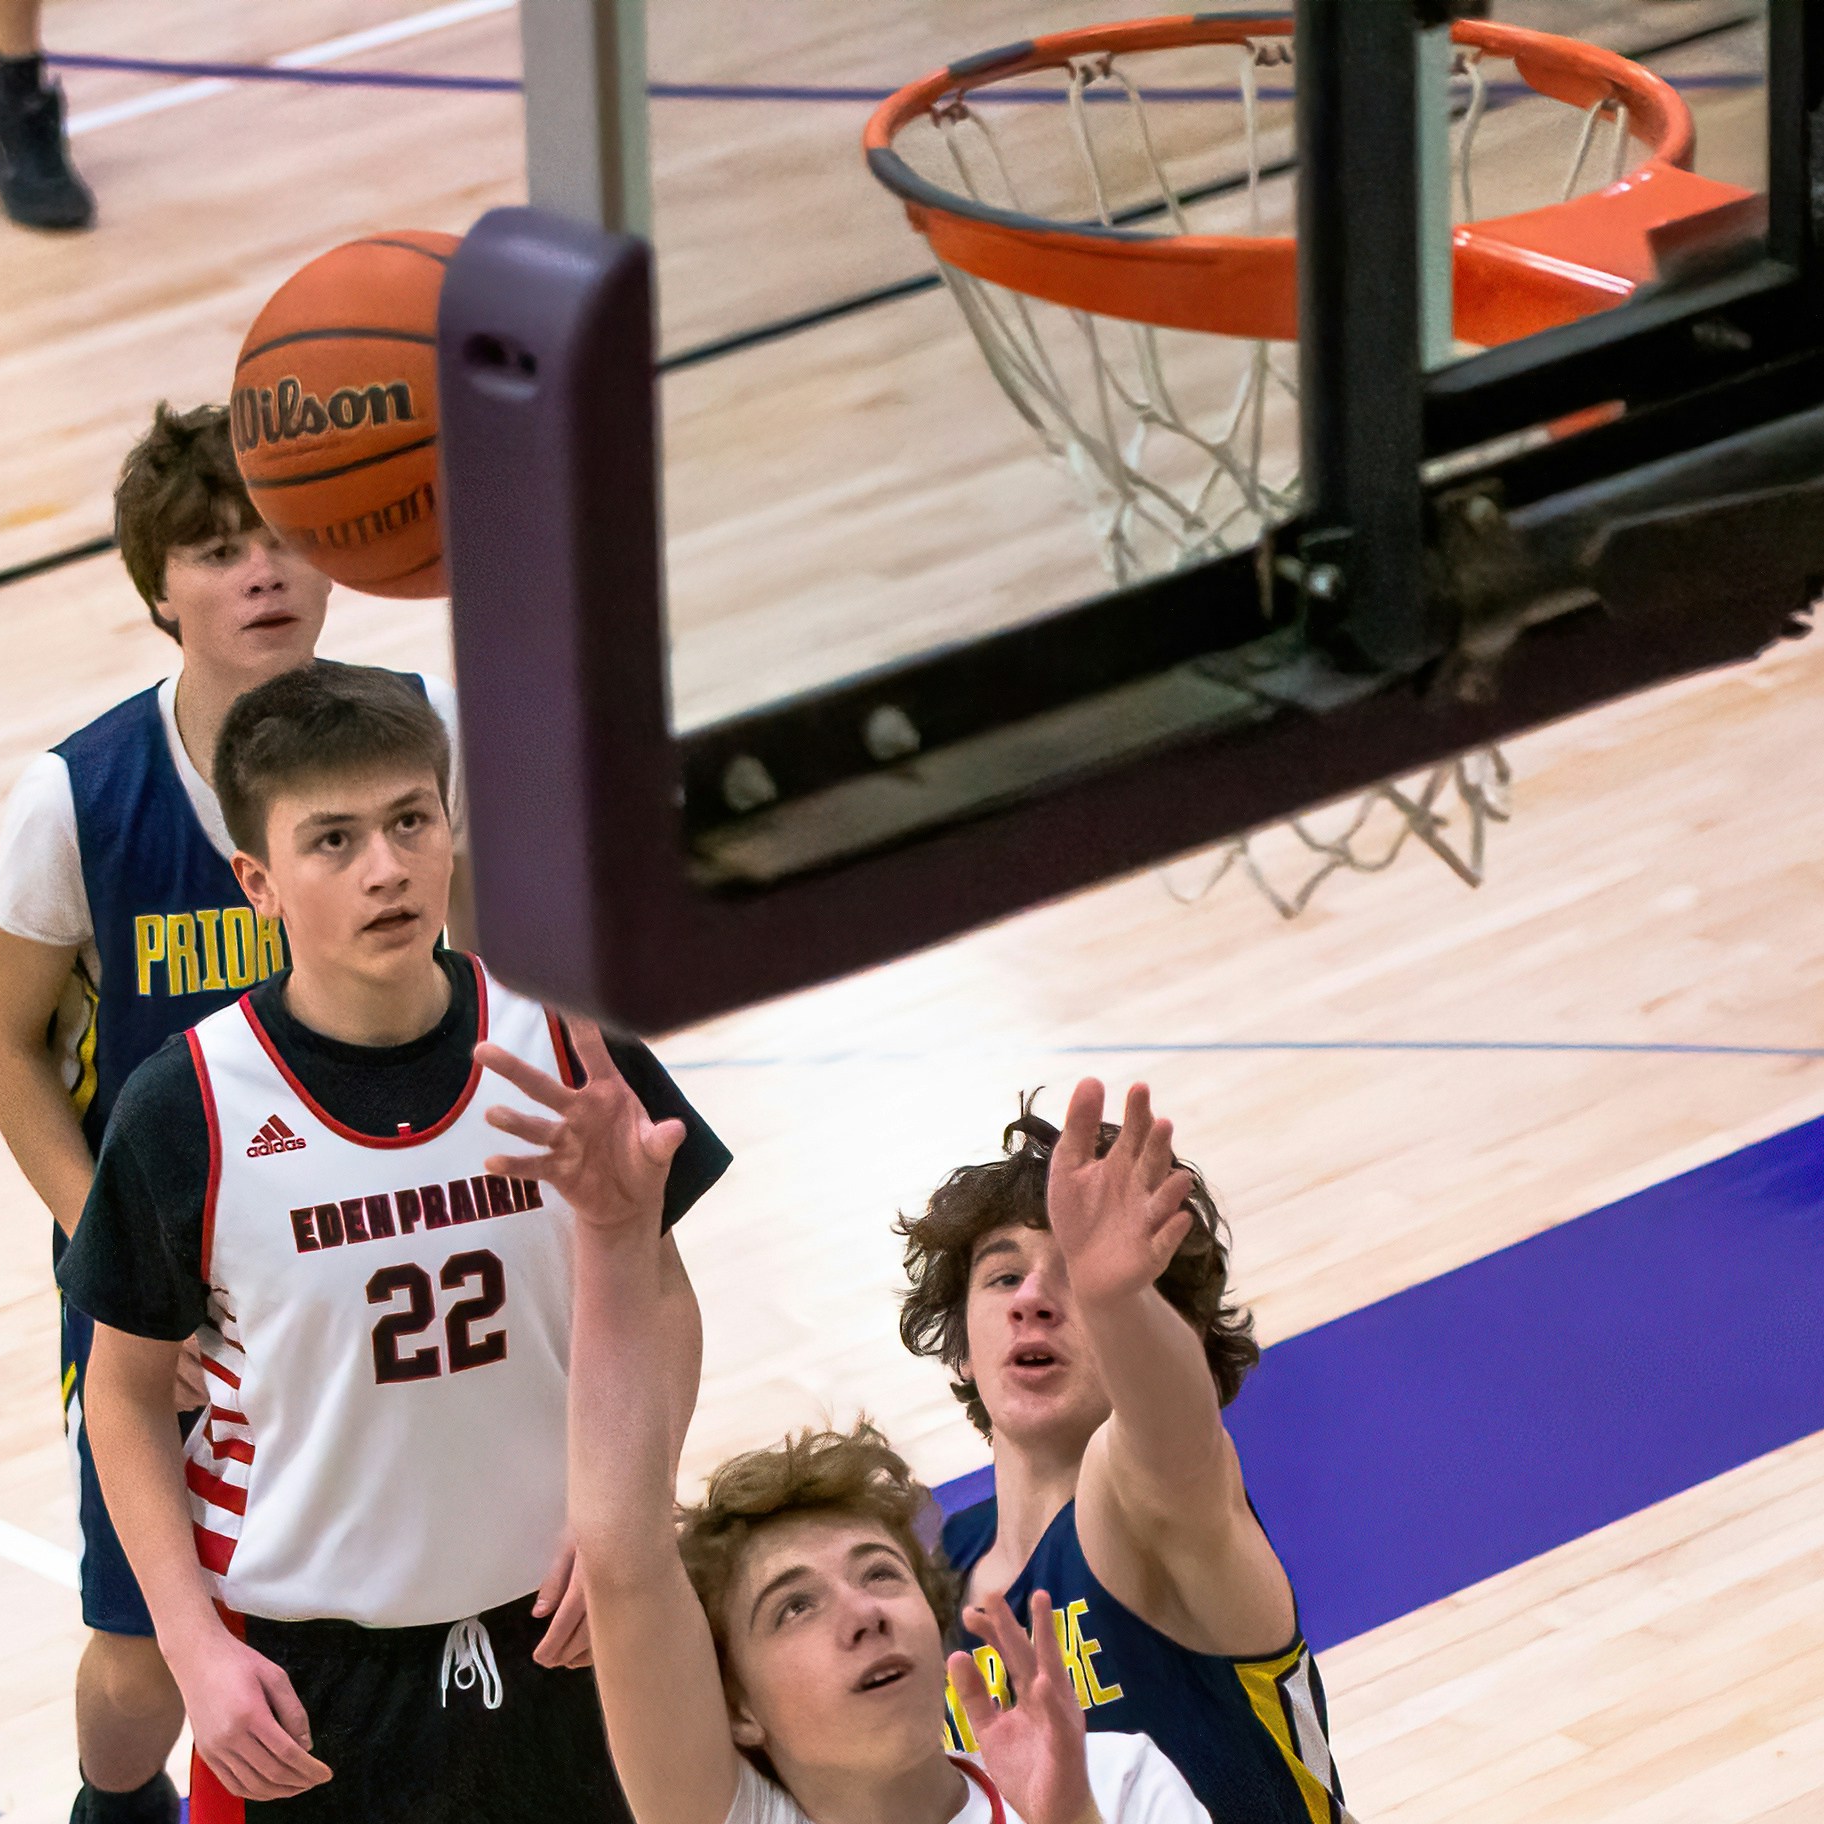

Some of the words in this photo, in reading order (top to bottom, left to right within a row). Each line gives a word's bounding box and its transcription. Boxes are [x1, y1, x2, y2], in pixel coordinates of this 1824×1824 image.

[231, 374, 415, 454] Wilson
[246, 1137, 307, 1158] adidas
[289, 1192, 396, 1254] EDEN
[394, 1173, 545, 1235] PRAIRIE
[365, 1248, 508, 1385] 22
